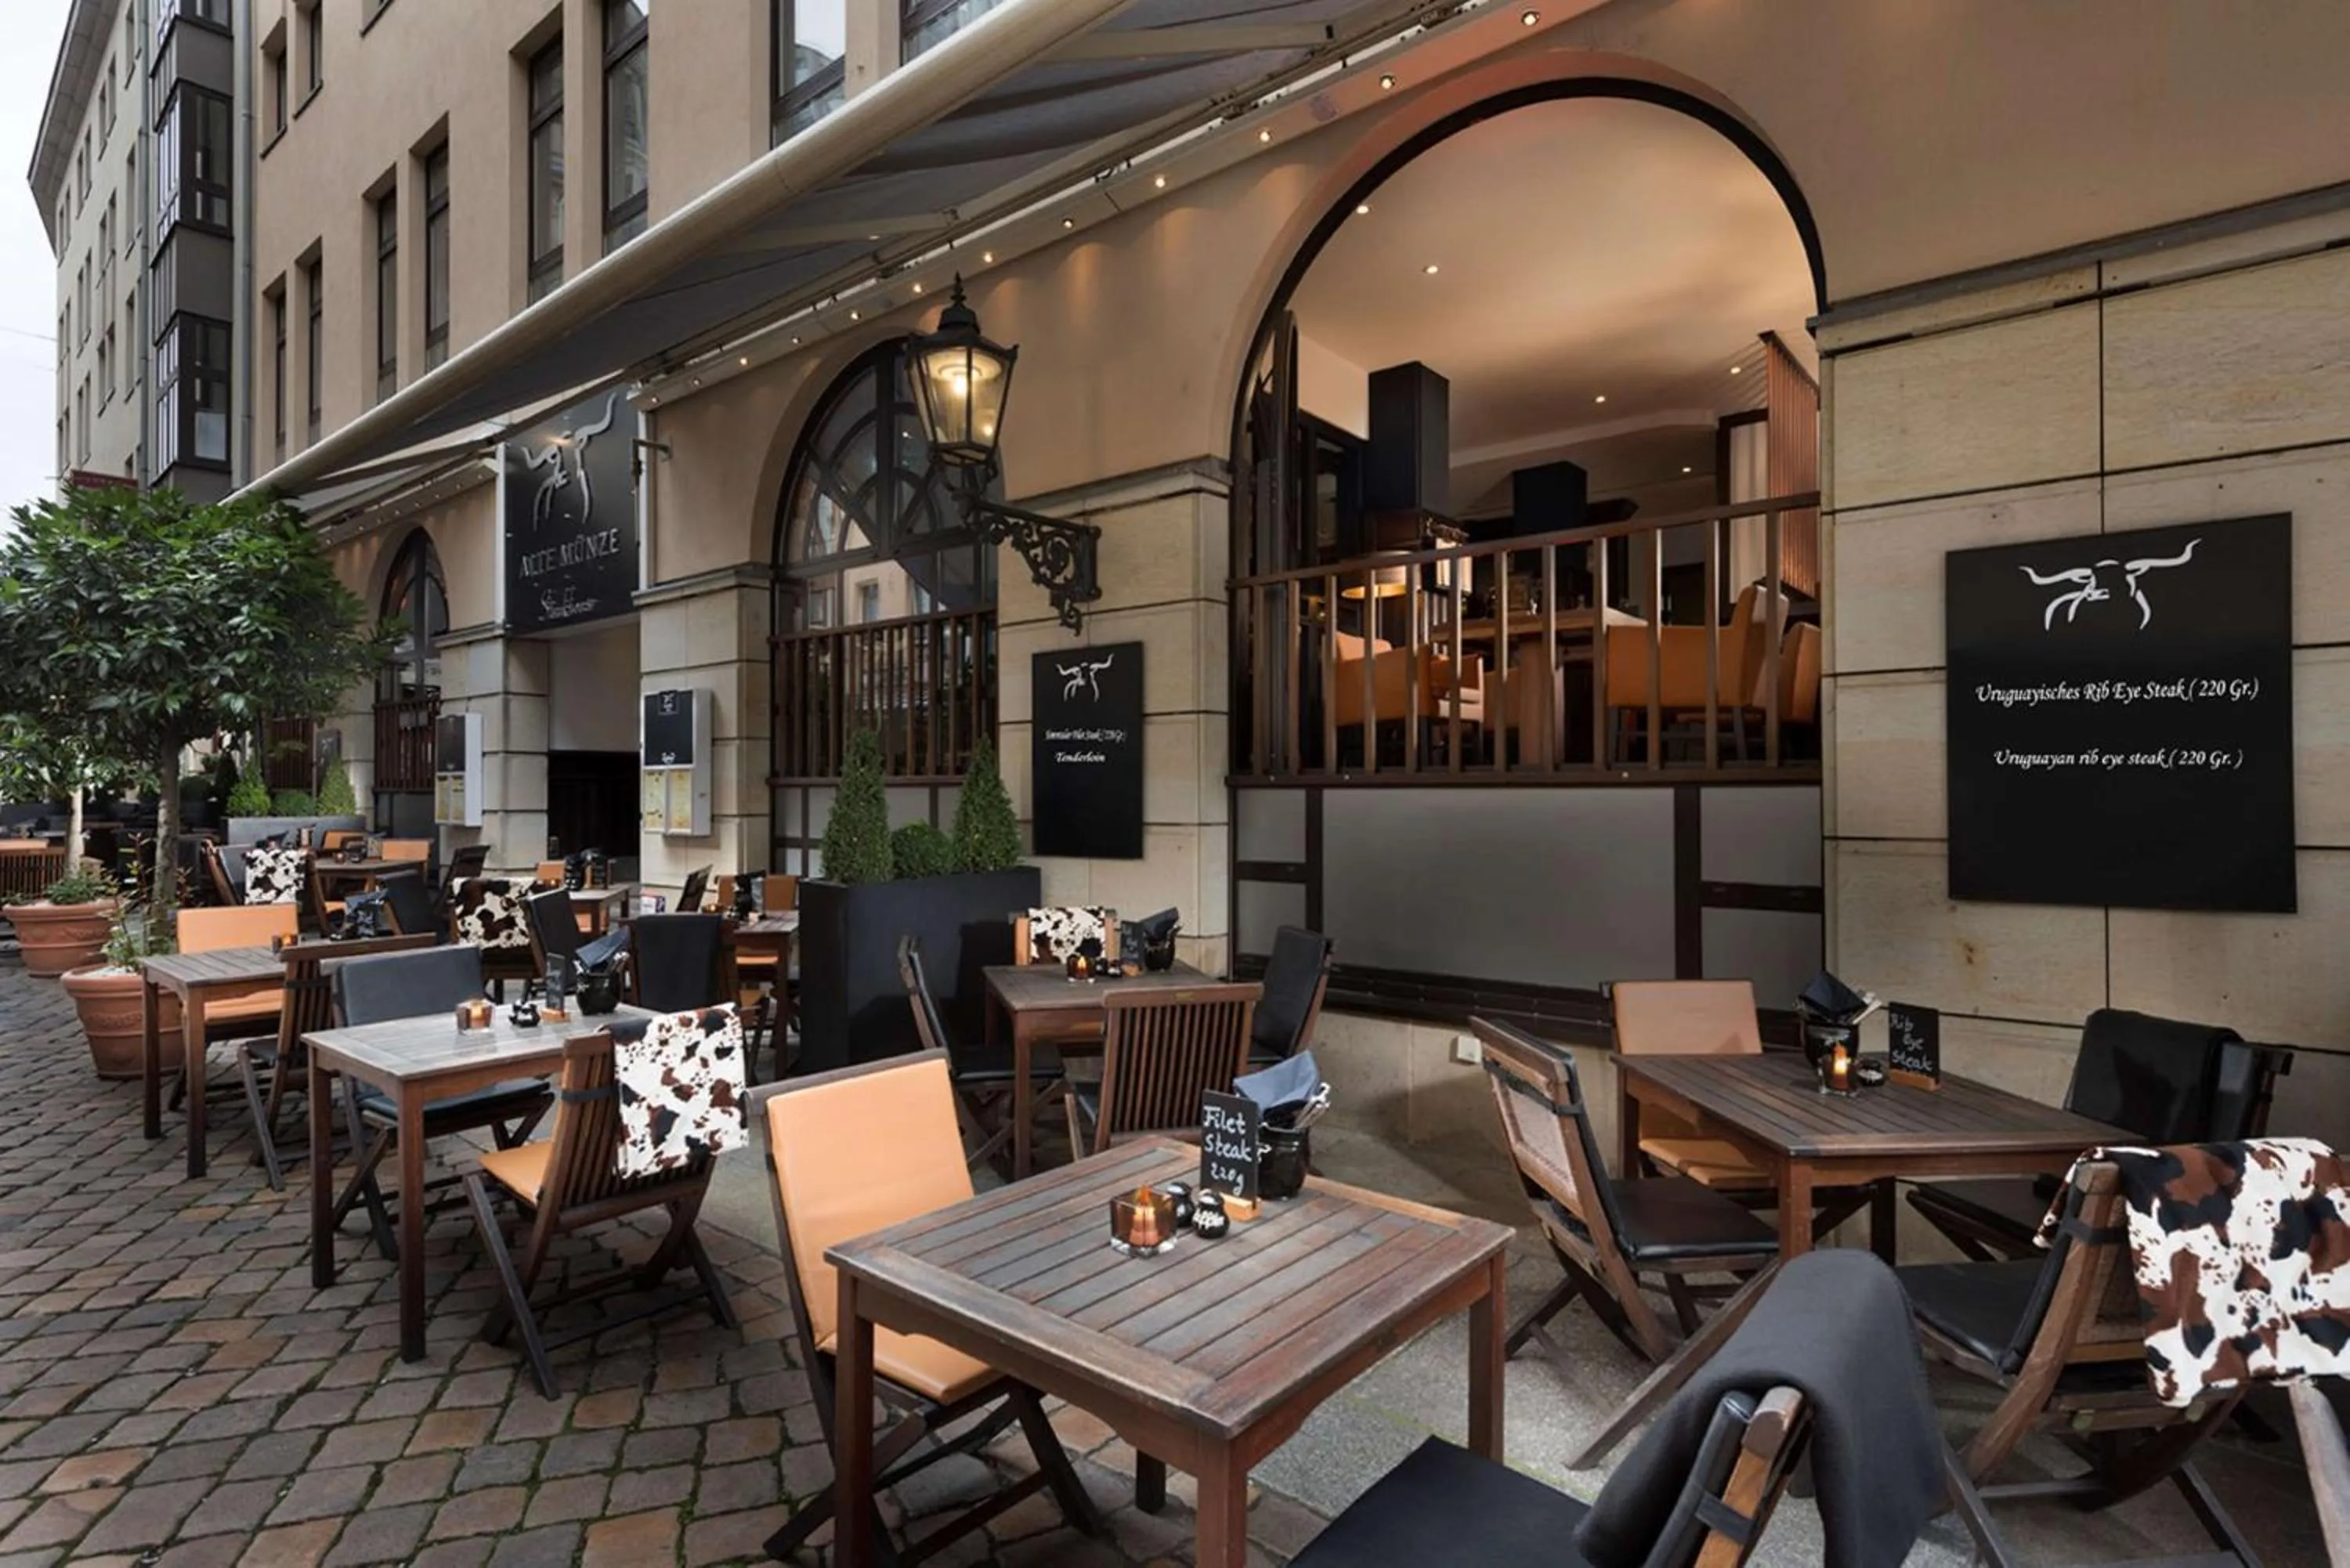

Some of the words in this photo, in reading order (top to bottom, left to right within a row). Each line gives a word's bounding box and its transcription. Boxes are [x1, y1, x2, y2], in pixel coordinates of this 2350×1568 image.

[1975, 680, 2081, 708] Uruguayisches
[2084, 680, 2110, 702] Rib
[2112, 681, 2141, 705] Eye
[1994, 748, 2076, 771] Uruguayan
[2078, 748, 2100, 765] rib
[2102, 753, 2125, 771] eye
[1203, 1106, 1246, 1134] Filet
[1203, 1133, 1253, 1162] Steak
